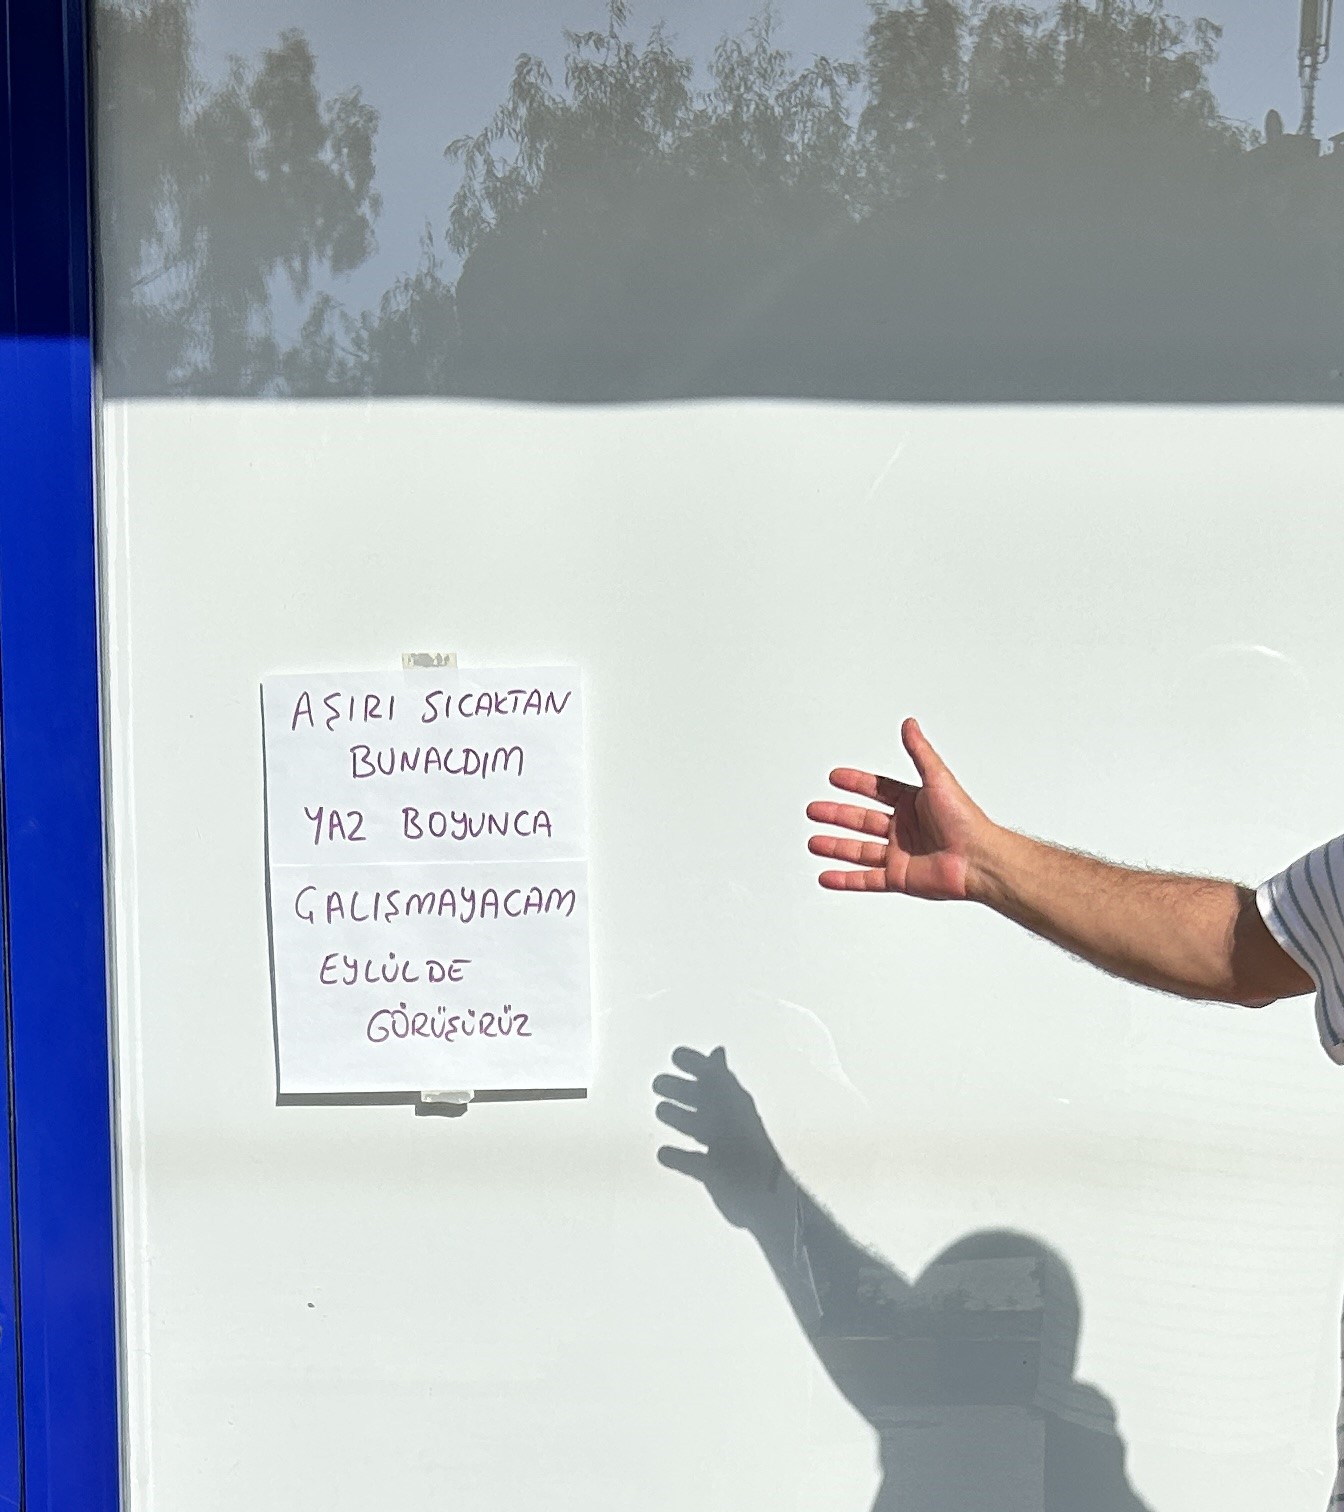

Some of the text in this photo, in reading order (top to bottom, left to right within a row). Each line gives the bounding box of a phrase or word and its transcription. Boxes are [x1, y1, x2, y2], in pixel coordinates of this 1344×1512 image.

[291, 688, 572, 732] AŞIRI SICAKTAN
[349, 744, 524, 780] BUNALDIM
[303, 806, 552, 846] YAZ BOYUNCA
[295, 885, 576, 925] ÇALIŞMAYACAM
[366, 1001, 532, 1043] GÖRÜŞÜRÜZ
